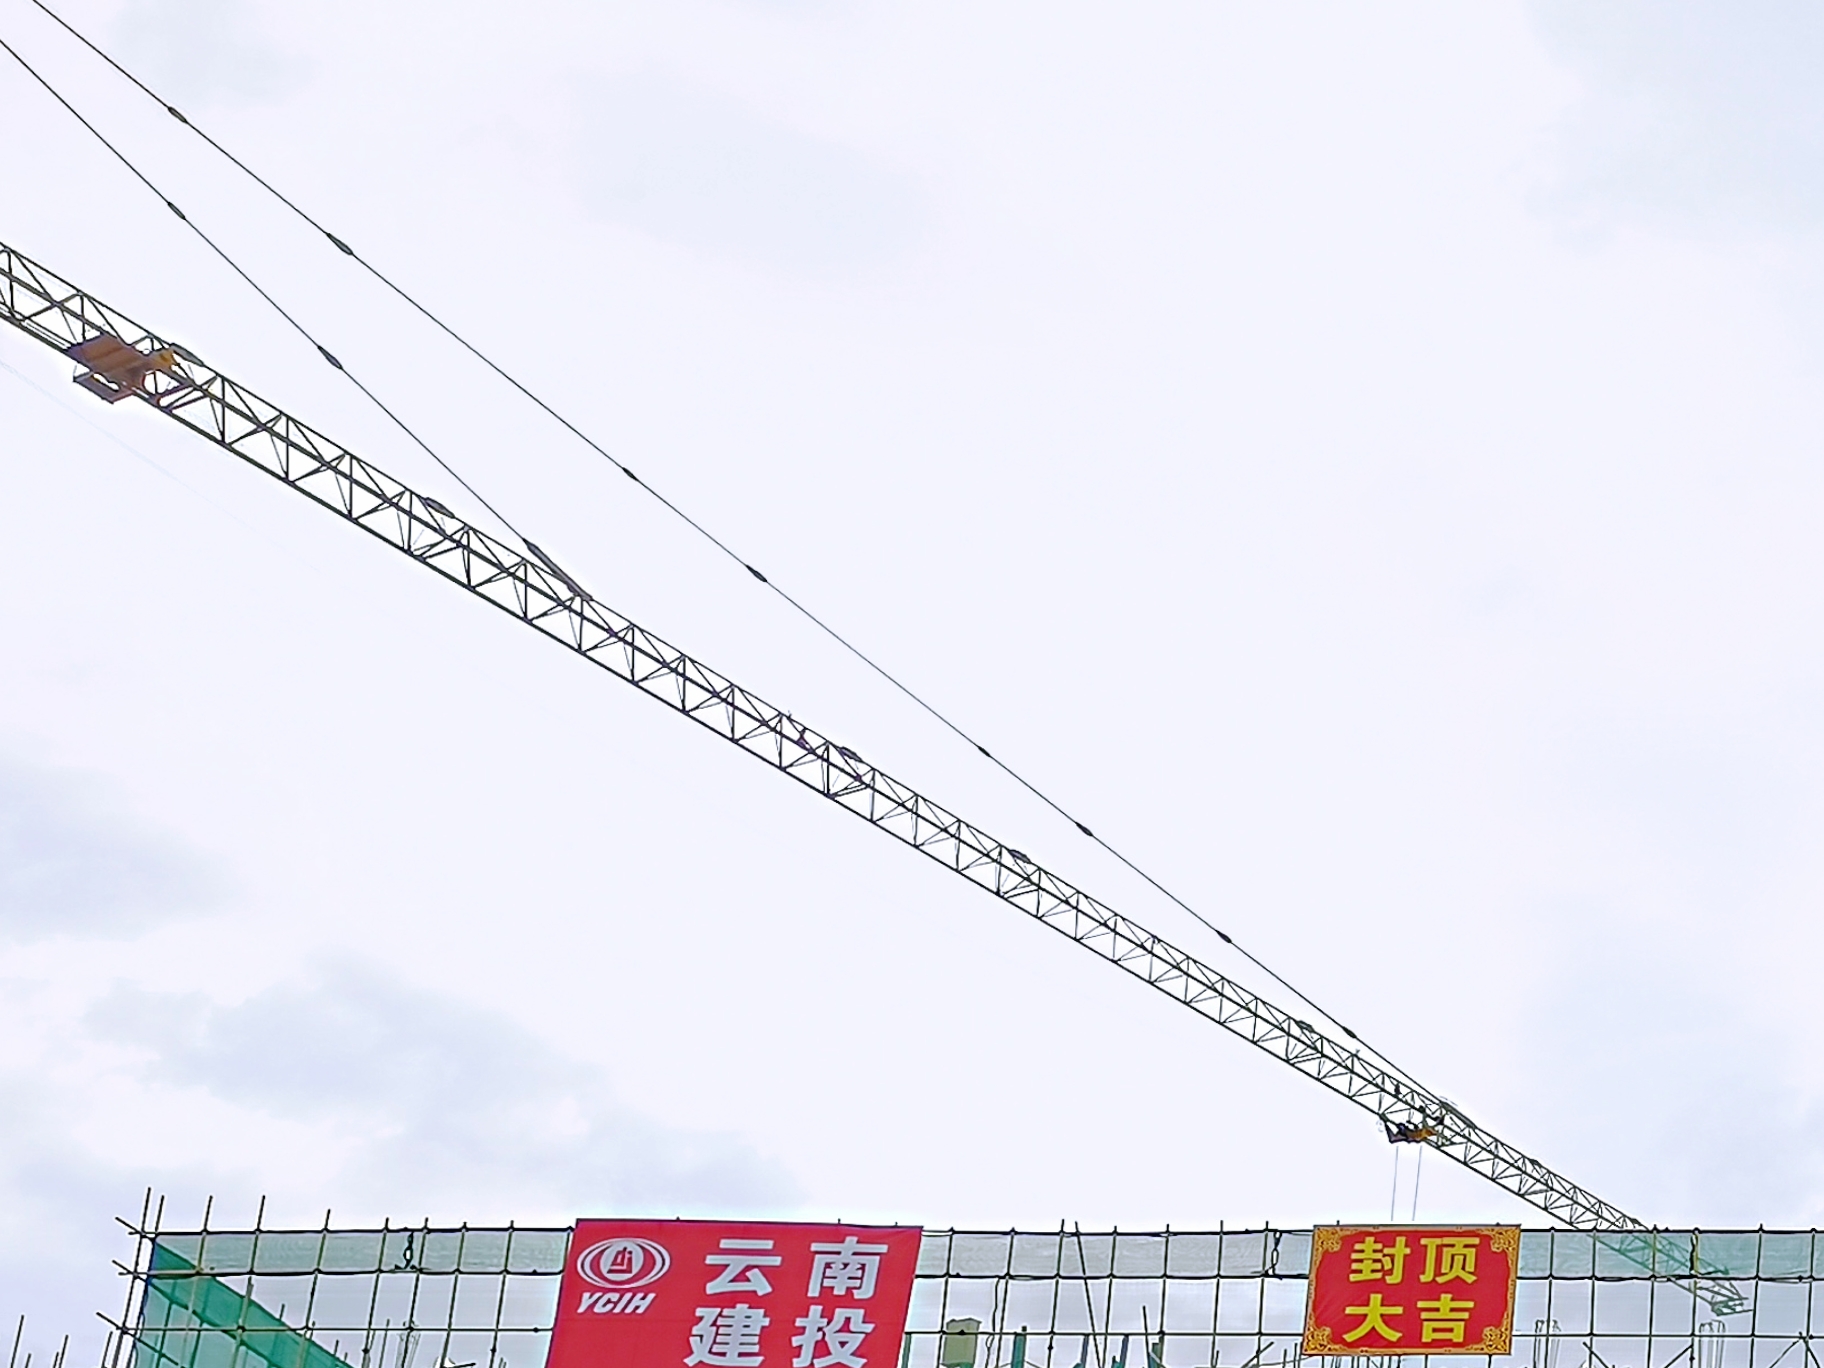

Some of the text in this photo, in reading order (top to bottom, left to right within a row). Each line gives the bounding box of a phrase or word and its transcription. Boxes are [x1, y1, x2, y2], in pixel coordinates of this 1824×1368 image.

[704, 1236, 888, 1299] 云南
[1348, 1236, 1480, 1284] 封顶
[577, 1292, 656, 1314] YCIH
[1342, 1293, 1474, 1343] 大吉
